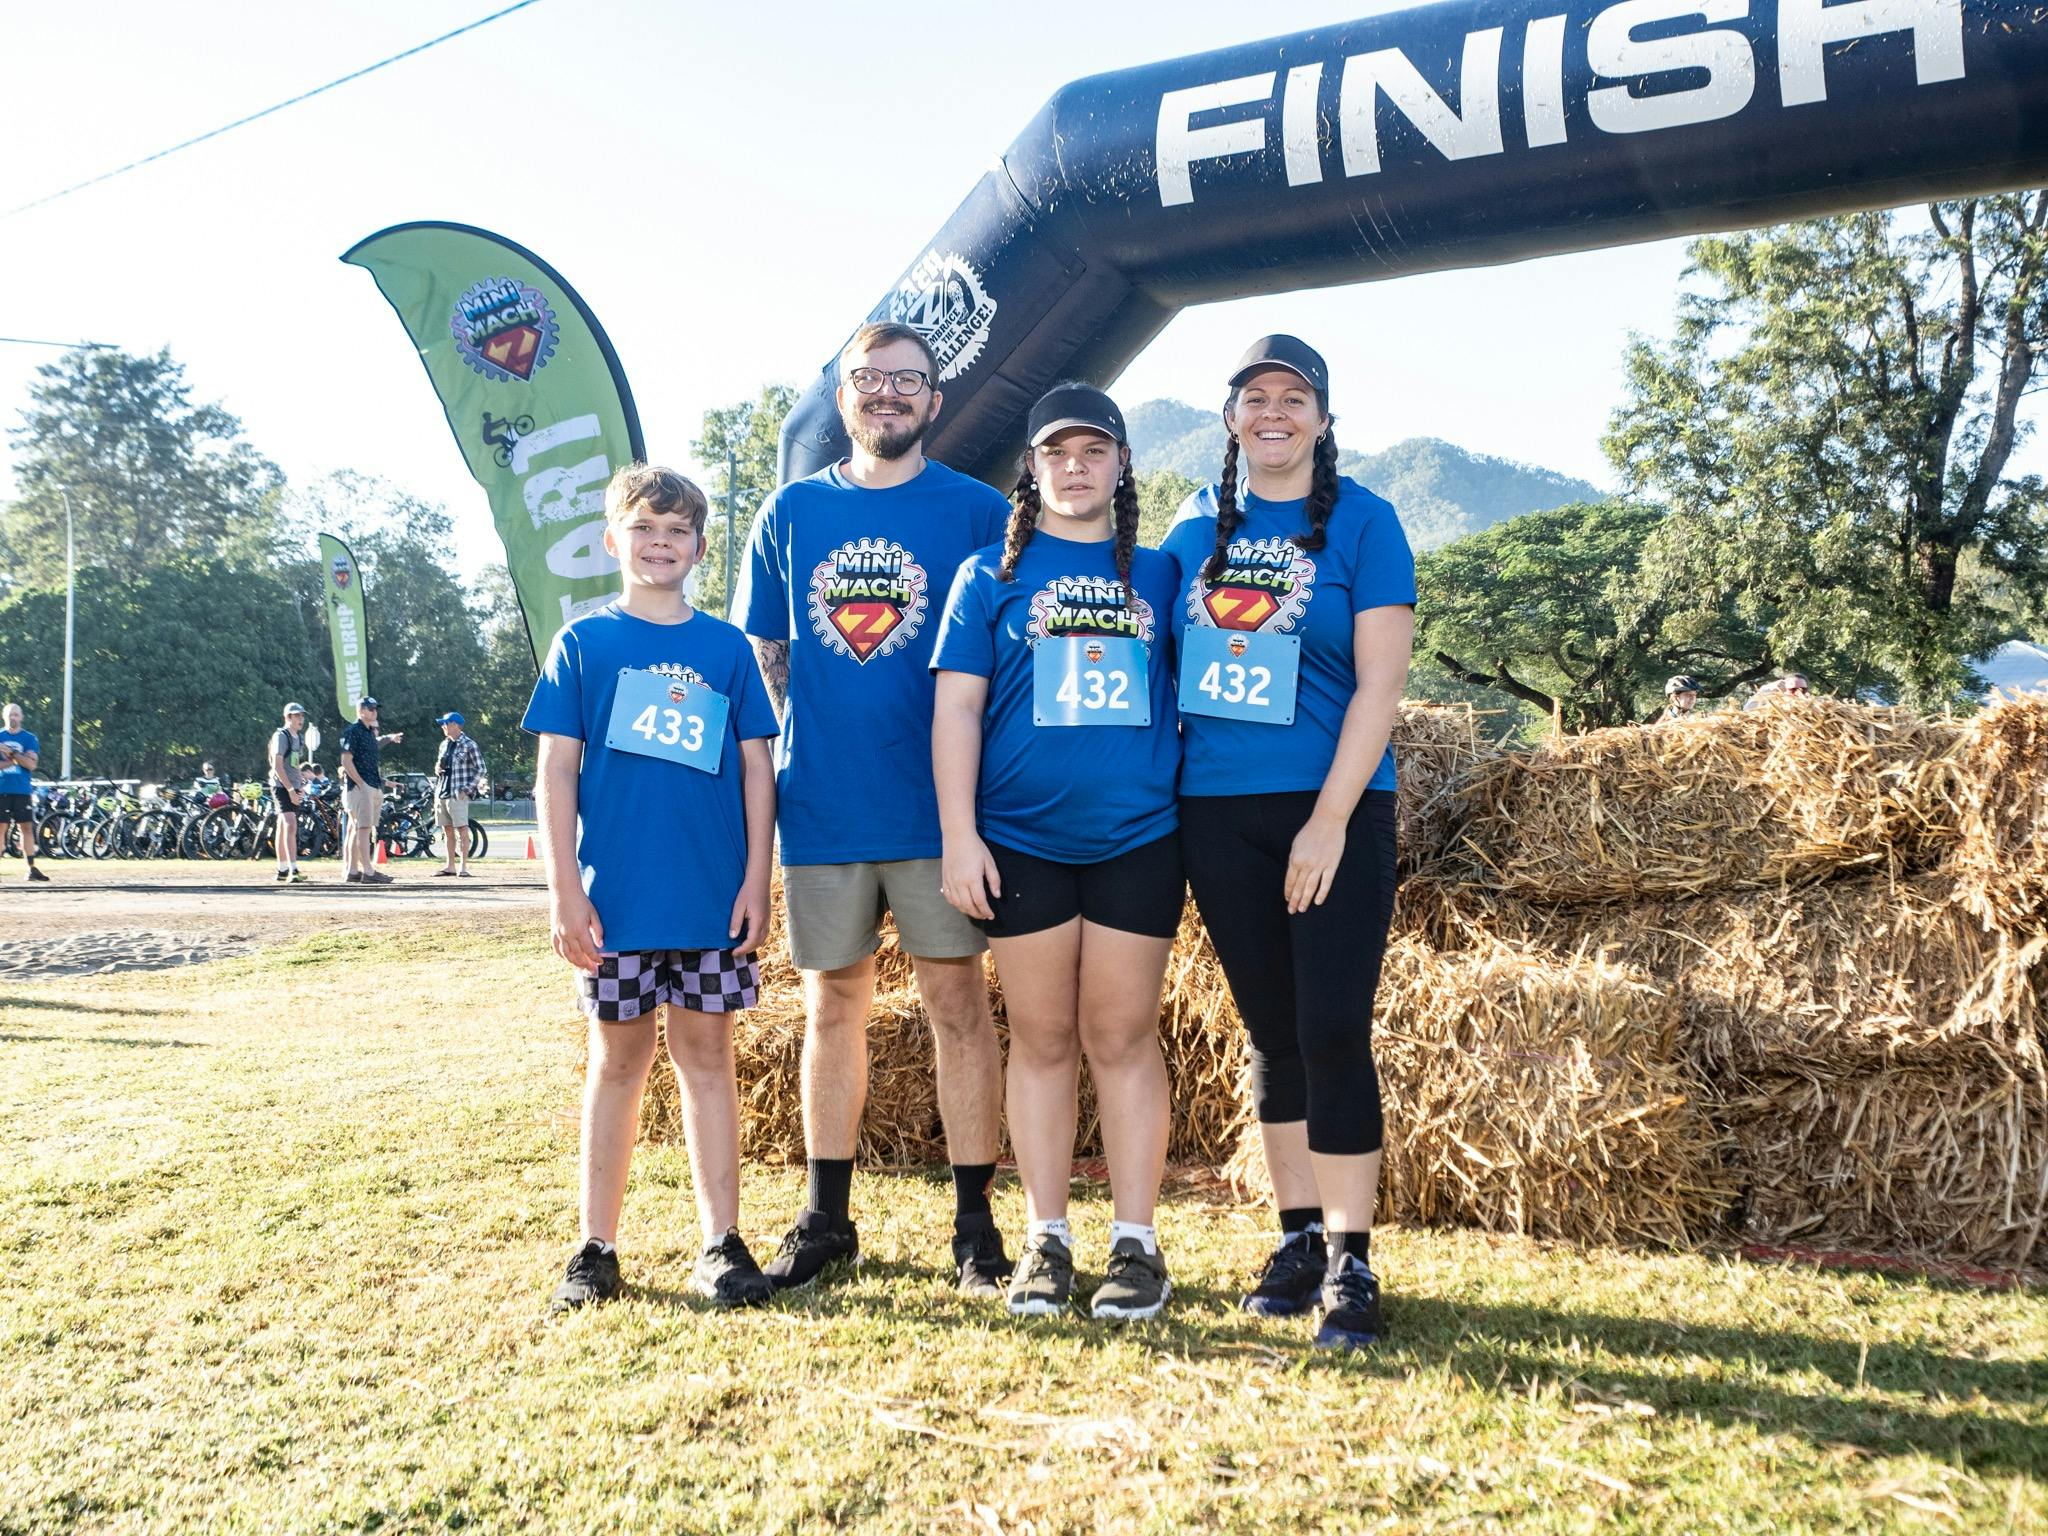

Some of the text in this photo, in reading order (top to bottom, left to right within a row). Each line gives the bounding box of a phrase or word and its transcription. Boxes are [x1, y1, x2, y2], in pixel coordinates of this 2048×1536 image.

[1156, 0, 1966, 207] FINISH
[465, 298, 540, 345] MACH
[928, 307, 961, 347] MBRACE
[936, 303, 993, 371] ALLENGE!
[940, 327, 957, 345] THE
[507, 413, 621, 624] TART
[824, 577, 911, 602] MACH
[1046, 605, 1139, 635] MACH
[1056, 670, 1129, 709] 432
[1198, 661, 1271, 706] 432
[631, 705, 705, 751] 433
